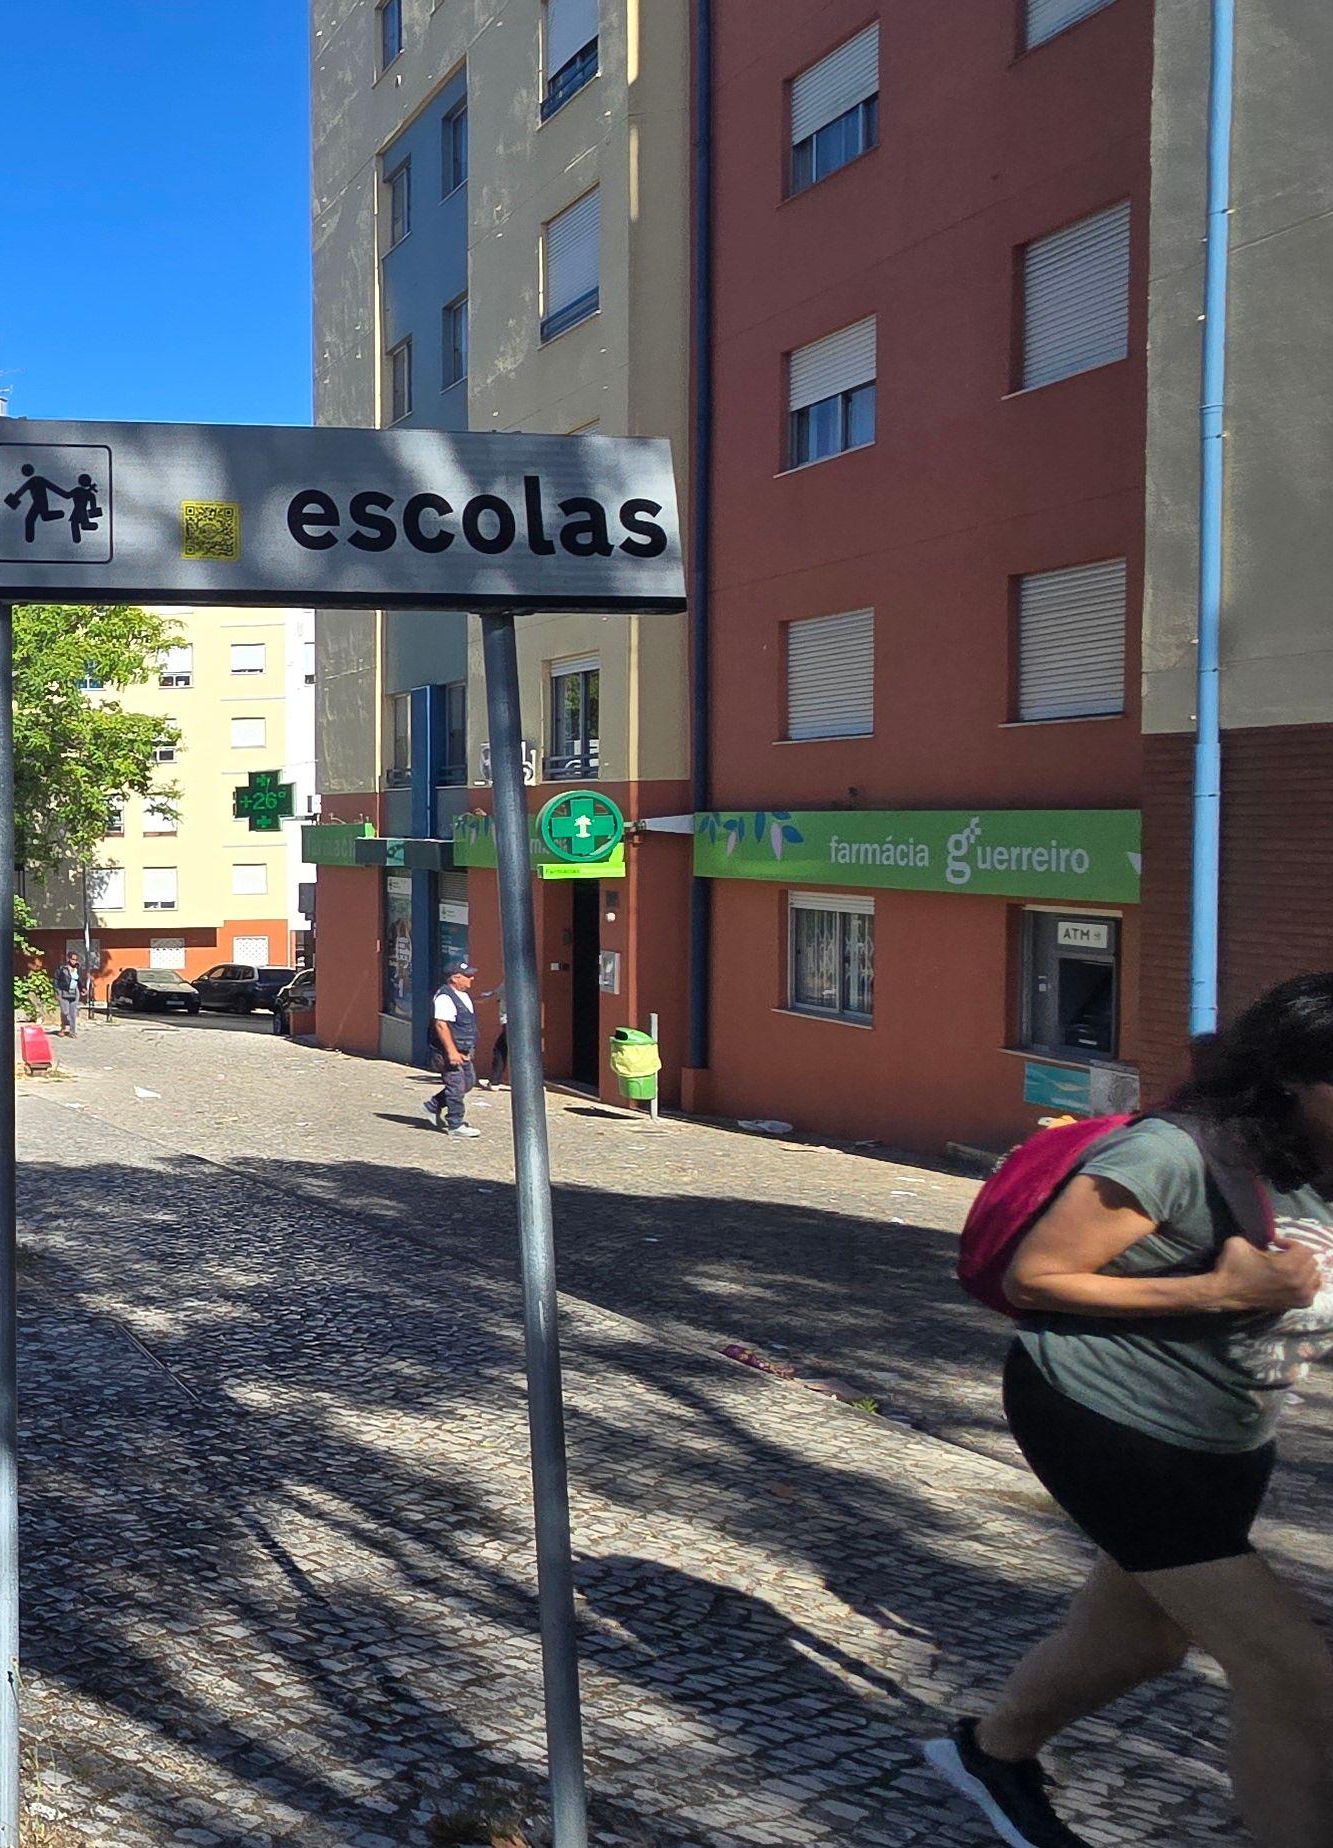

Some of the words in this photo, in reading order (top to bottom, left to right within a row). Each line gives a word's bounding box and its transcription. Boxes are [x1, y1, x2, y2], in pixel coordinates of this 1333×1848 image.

[287, 475, 668, 558] escolas
[829, 834, 930, 868] farmácia
[945, 817, 1090, 886] guerreiro
[1062, 927, 1091, 941] ATM
